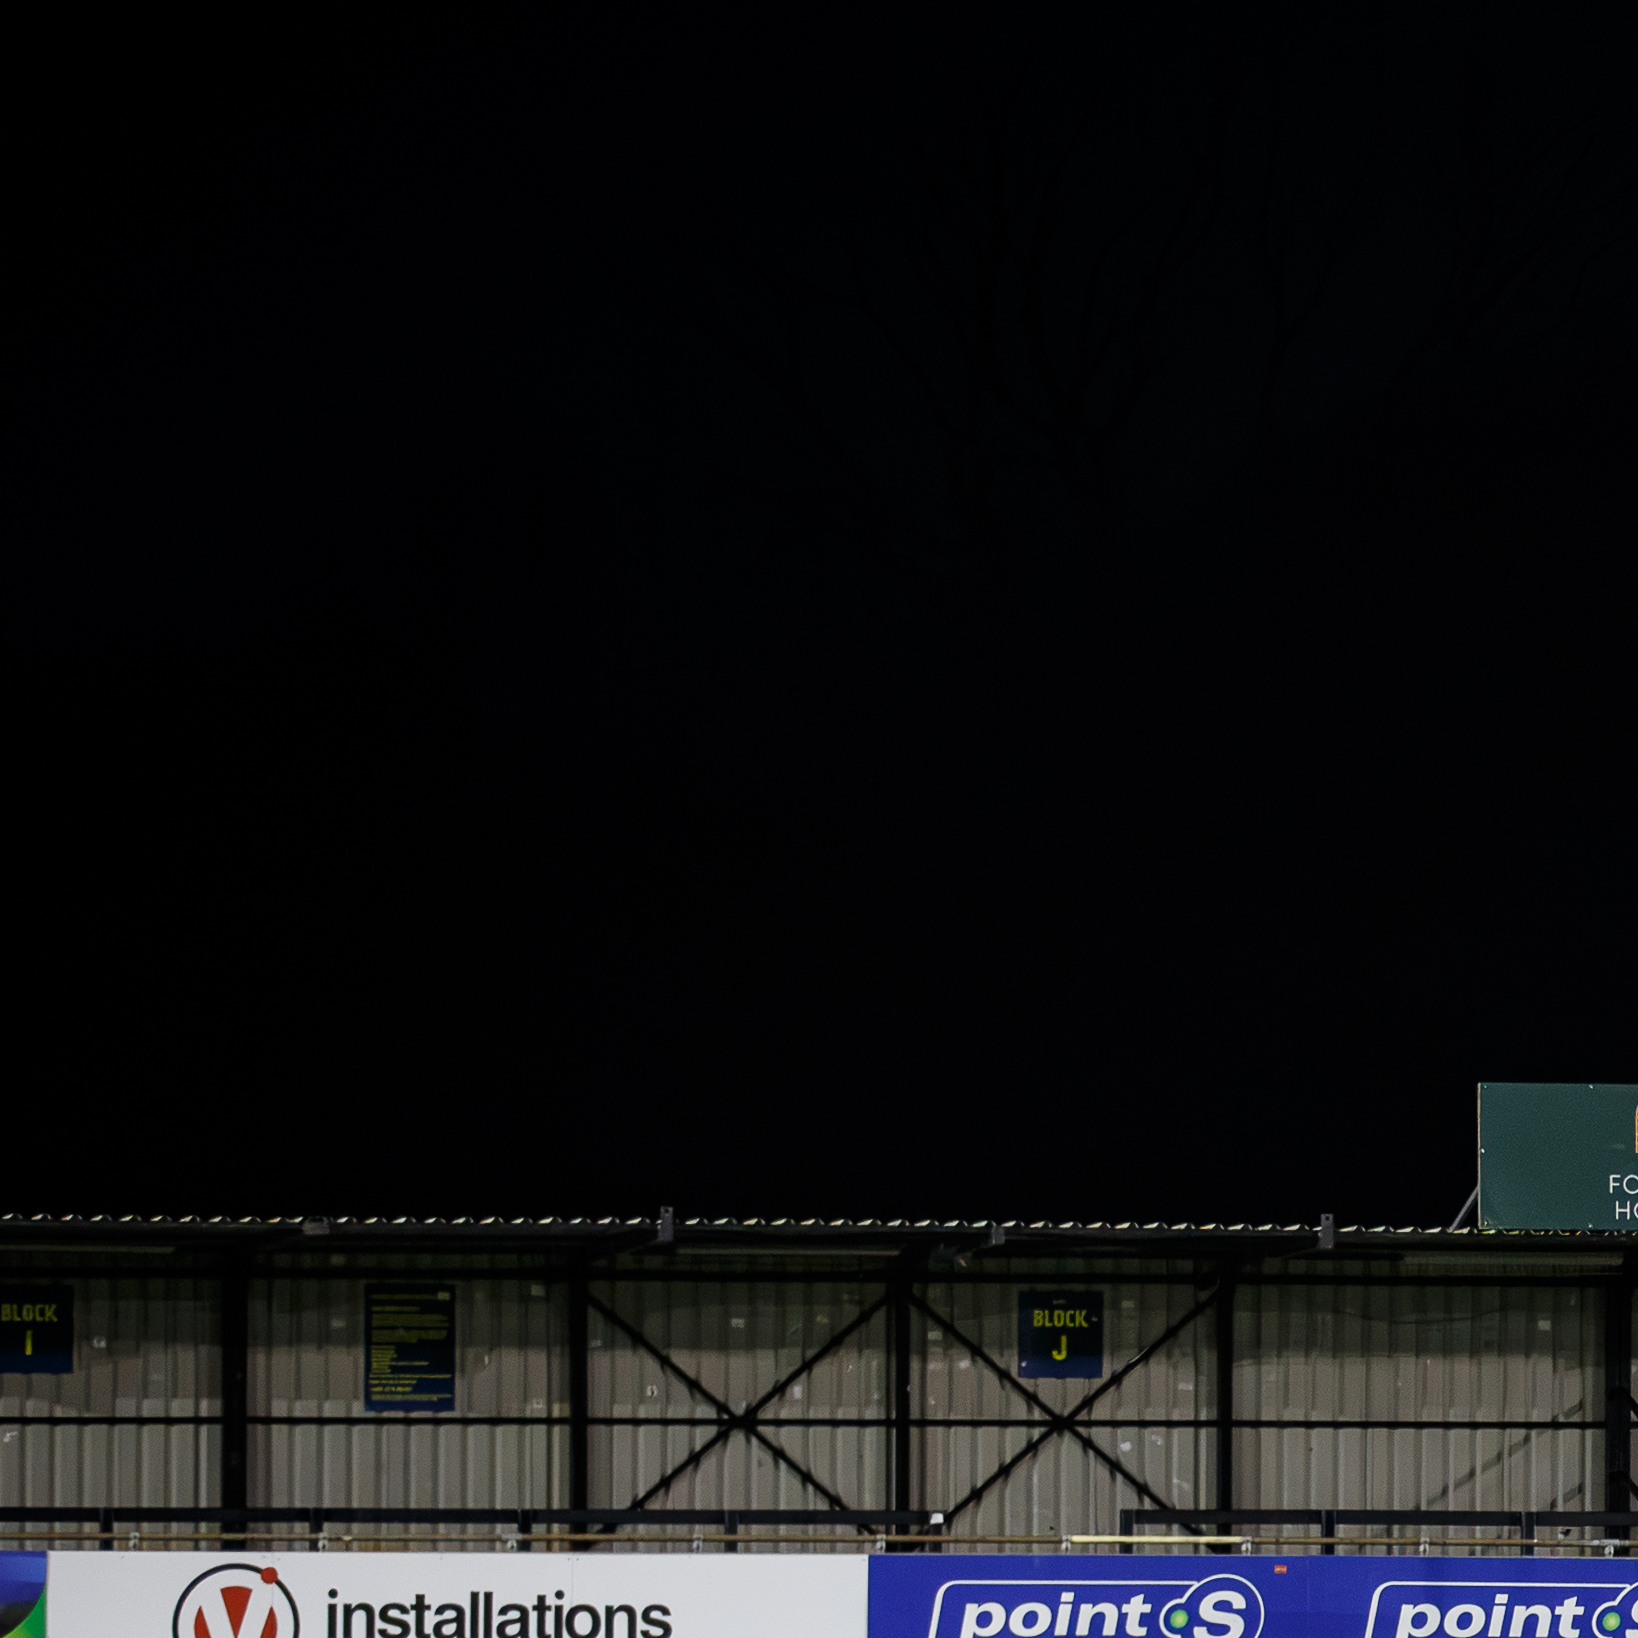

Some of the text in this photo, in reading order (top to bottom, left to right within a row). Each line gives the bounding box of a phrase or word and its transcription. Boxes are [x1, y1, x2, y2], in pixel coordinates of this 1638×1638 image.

[1, 1303, 58, 1322] BLOCK
[1033, 1310, 1089, 1328] BLOCK
[1051, 1334, 1068, 1361] J
